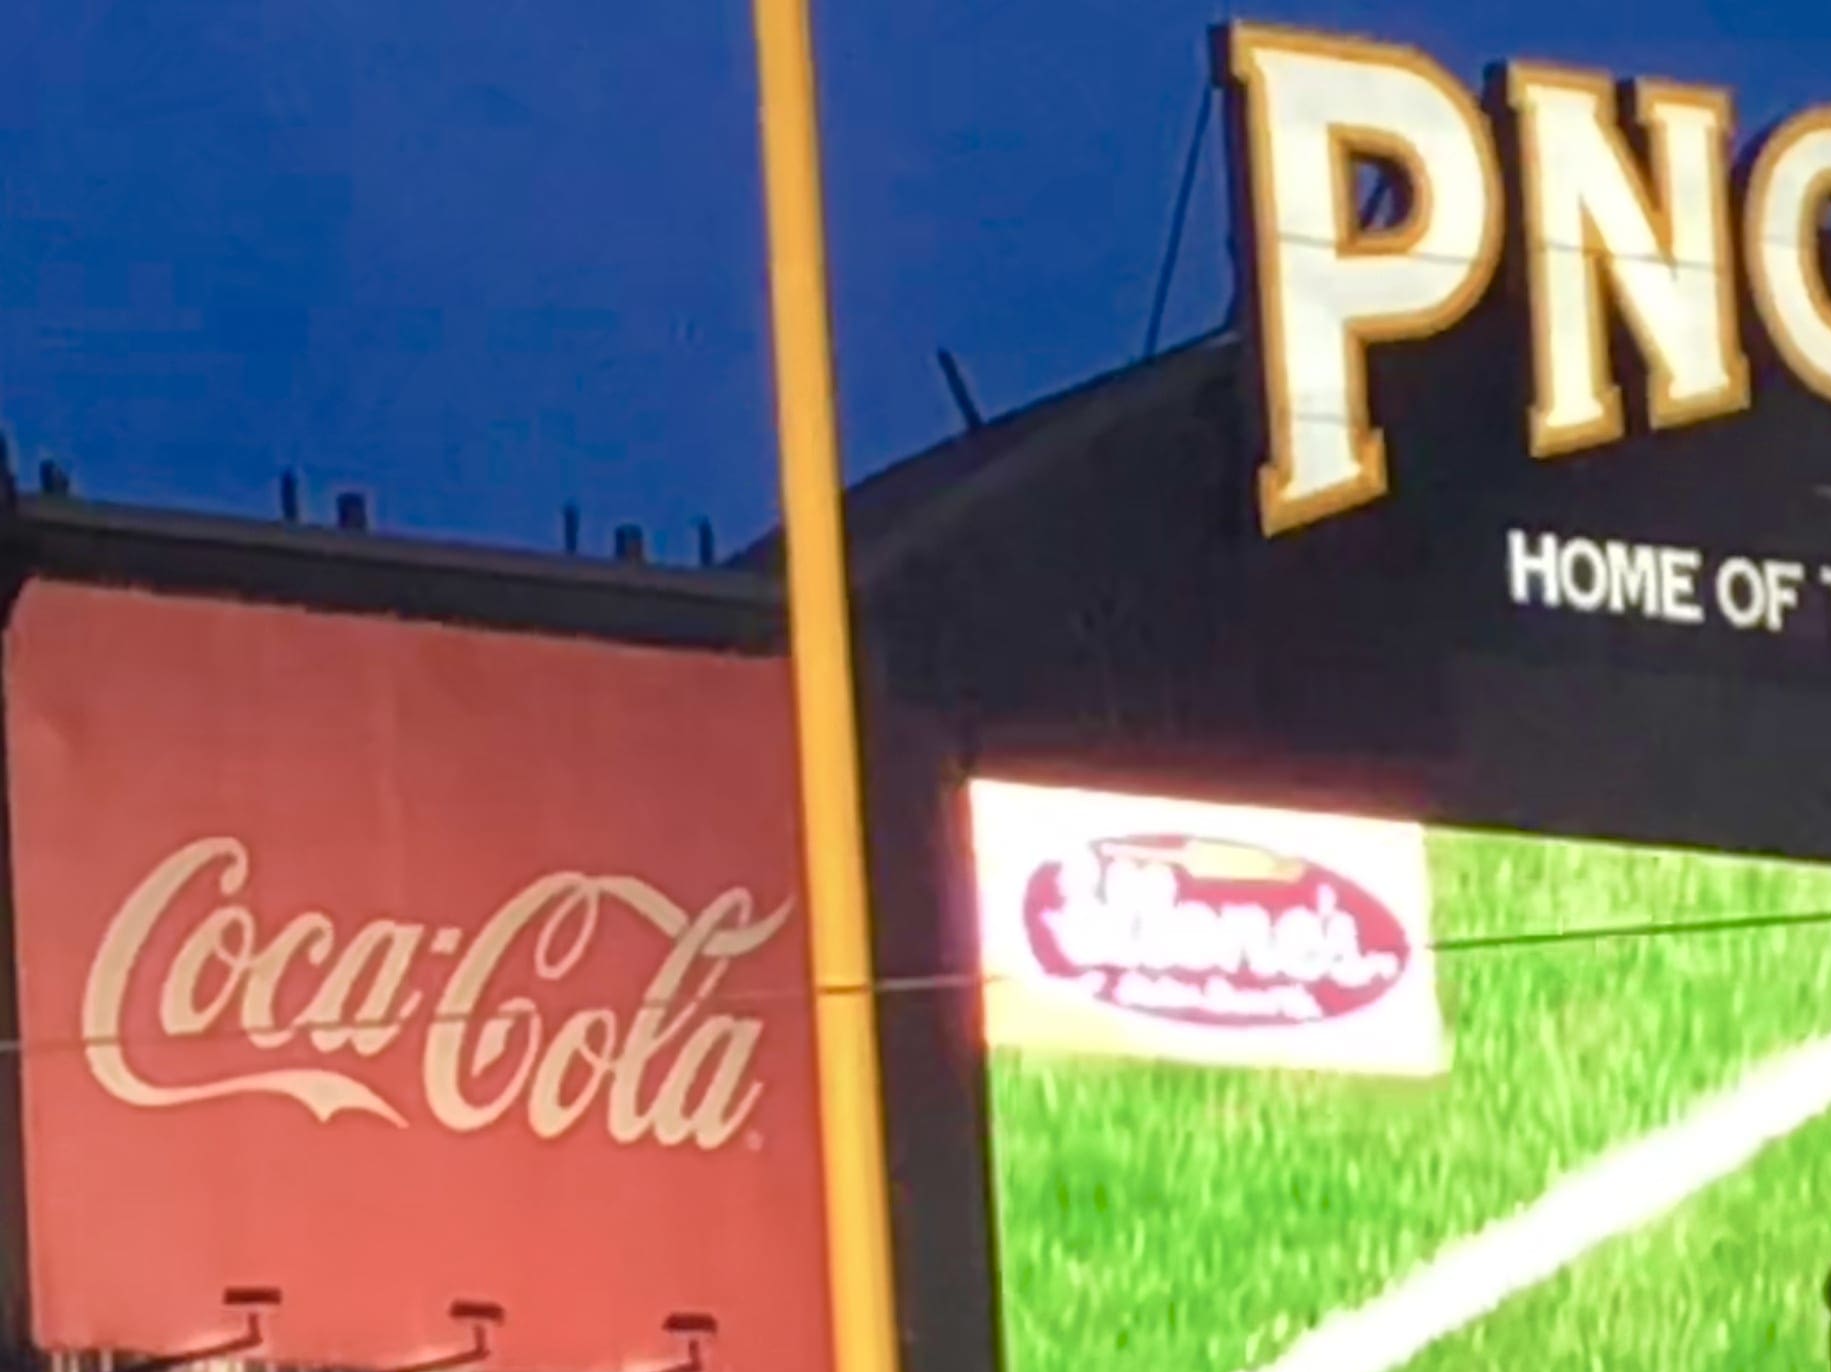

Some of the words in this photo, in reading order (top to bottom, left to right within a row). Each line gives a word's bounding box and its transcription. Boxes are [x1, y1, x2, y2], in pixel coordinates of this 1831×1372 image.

[1507, 528, 1706, 625] HOME
[1715, 556, 1805, 633] OF
[82, 836, 796, 1152] Coca-Cola
